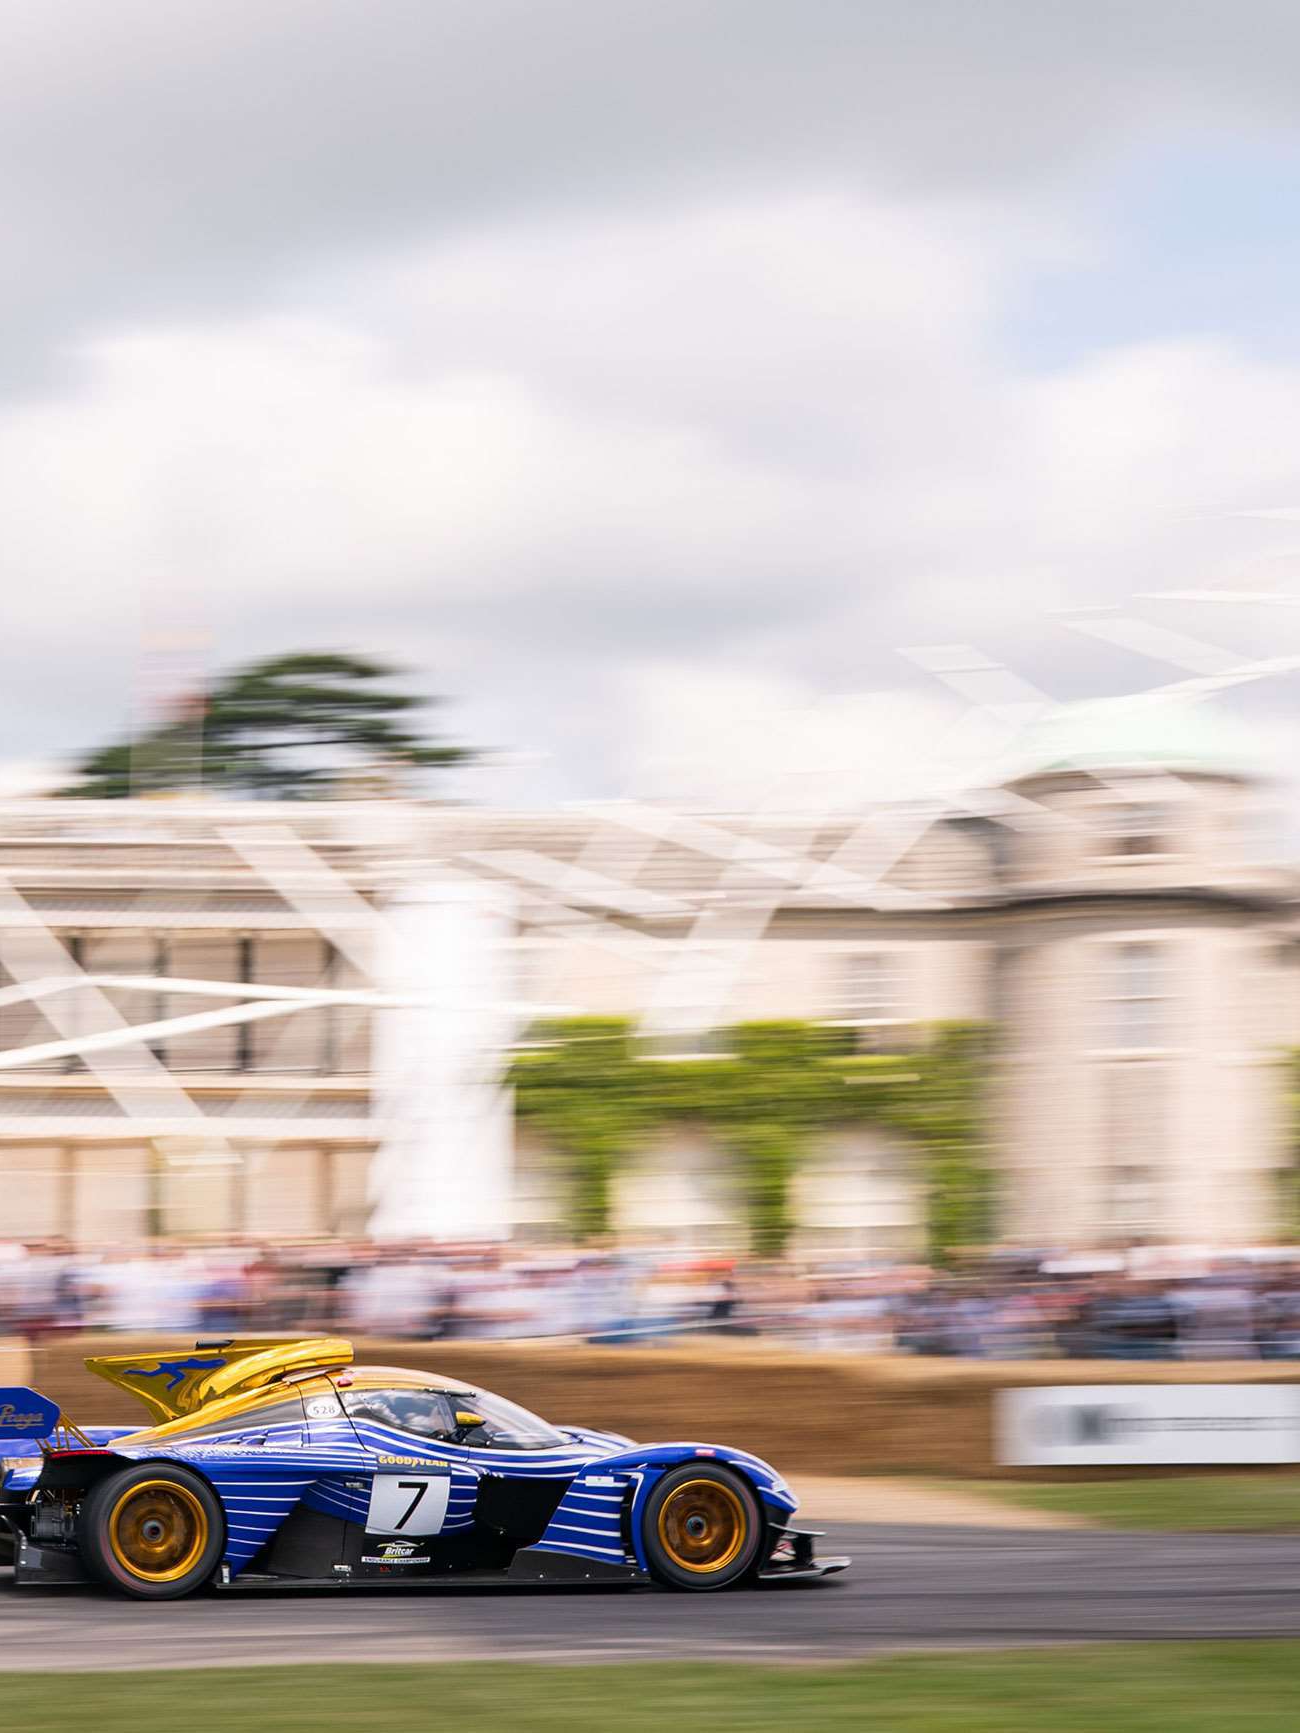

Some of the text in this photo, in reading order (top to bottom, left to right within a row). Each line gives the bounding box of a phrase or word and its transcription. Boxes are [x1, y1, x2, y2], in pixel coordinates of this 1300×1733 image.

[379, 1456, 448, 1467] GOODYEAR
[394, 1482, 428, 1529] 7
[385, 1547, 414, 1556] Britcar
